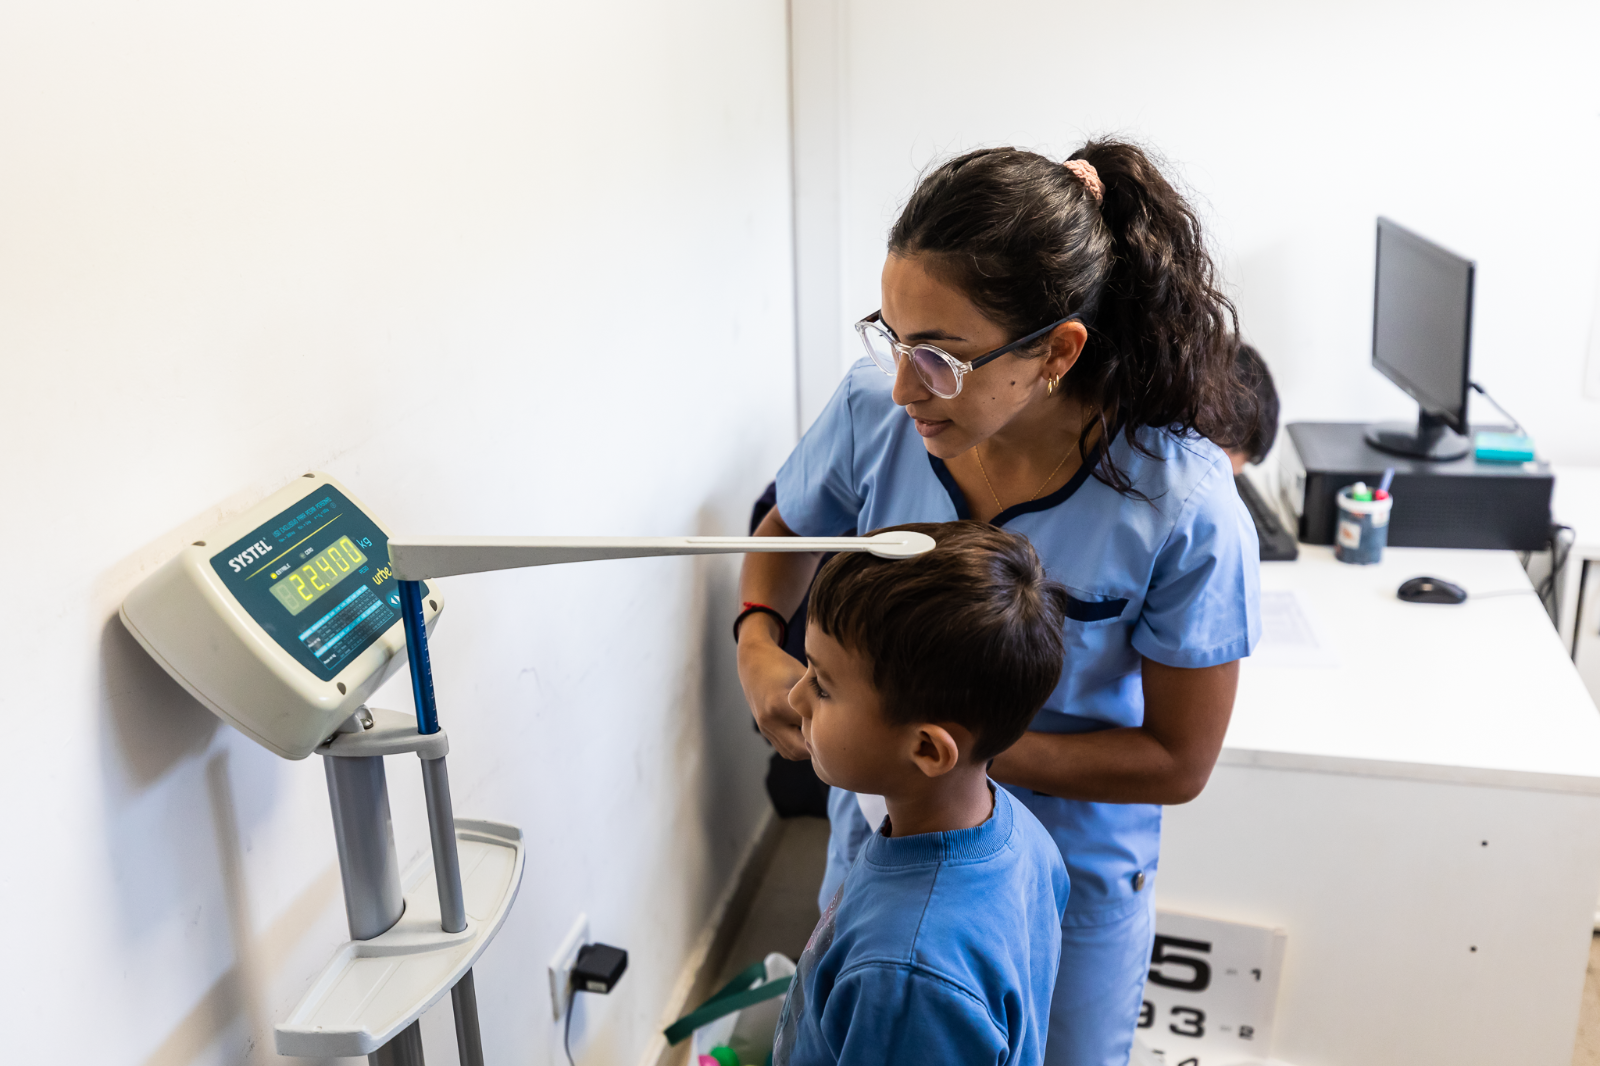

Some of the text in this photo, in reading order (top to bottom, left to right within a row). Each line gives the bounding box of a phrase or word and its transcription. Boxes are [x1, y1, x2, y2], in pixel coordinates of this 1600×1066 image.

[228, 539, 273, 573] SYSTEL
[356, 536, 373, 549] kg
[1148, 934, 1212, 993] 5
[1169, 1005, 1206, 1038] 3
